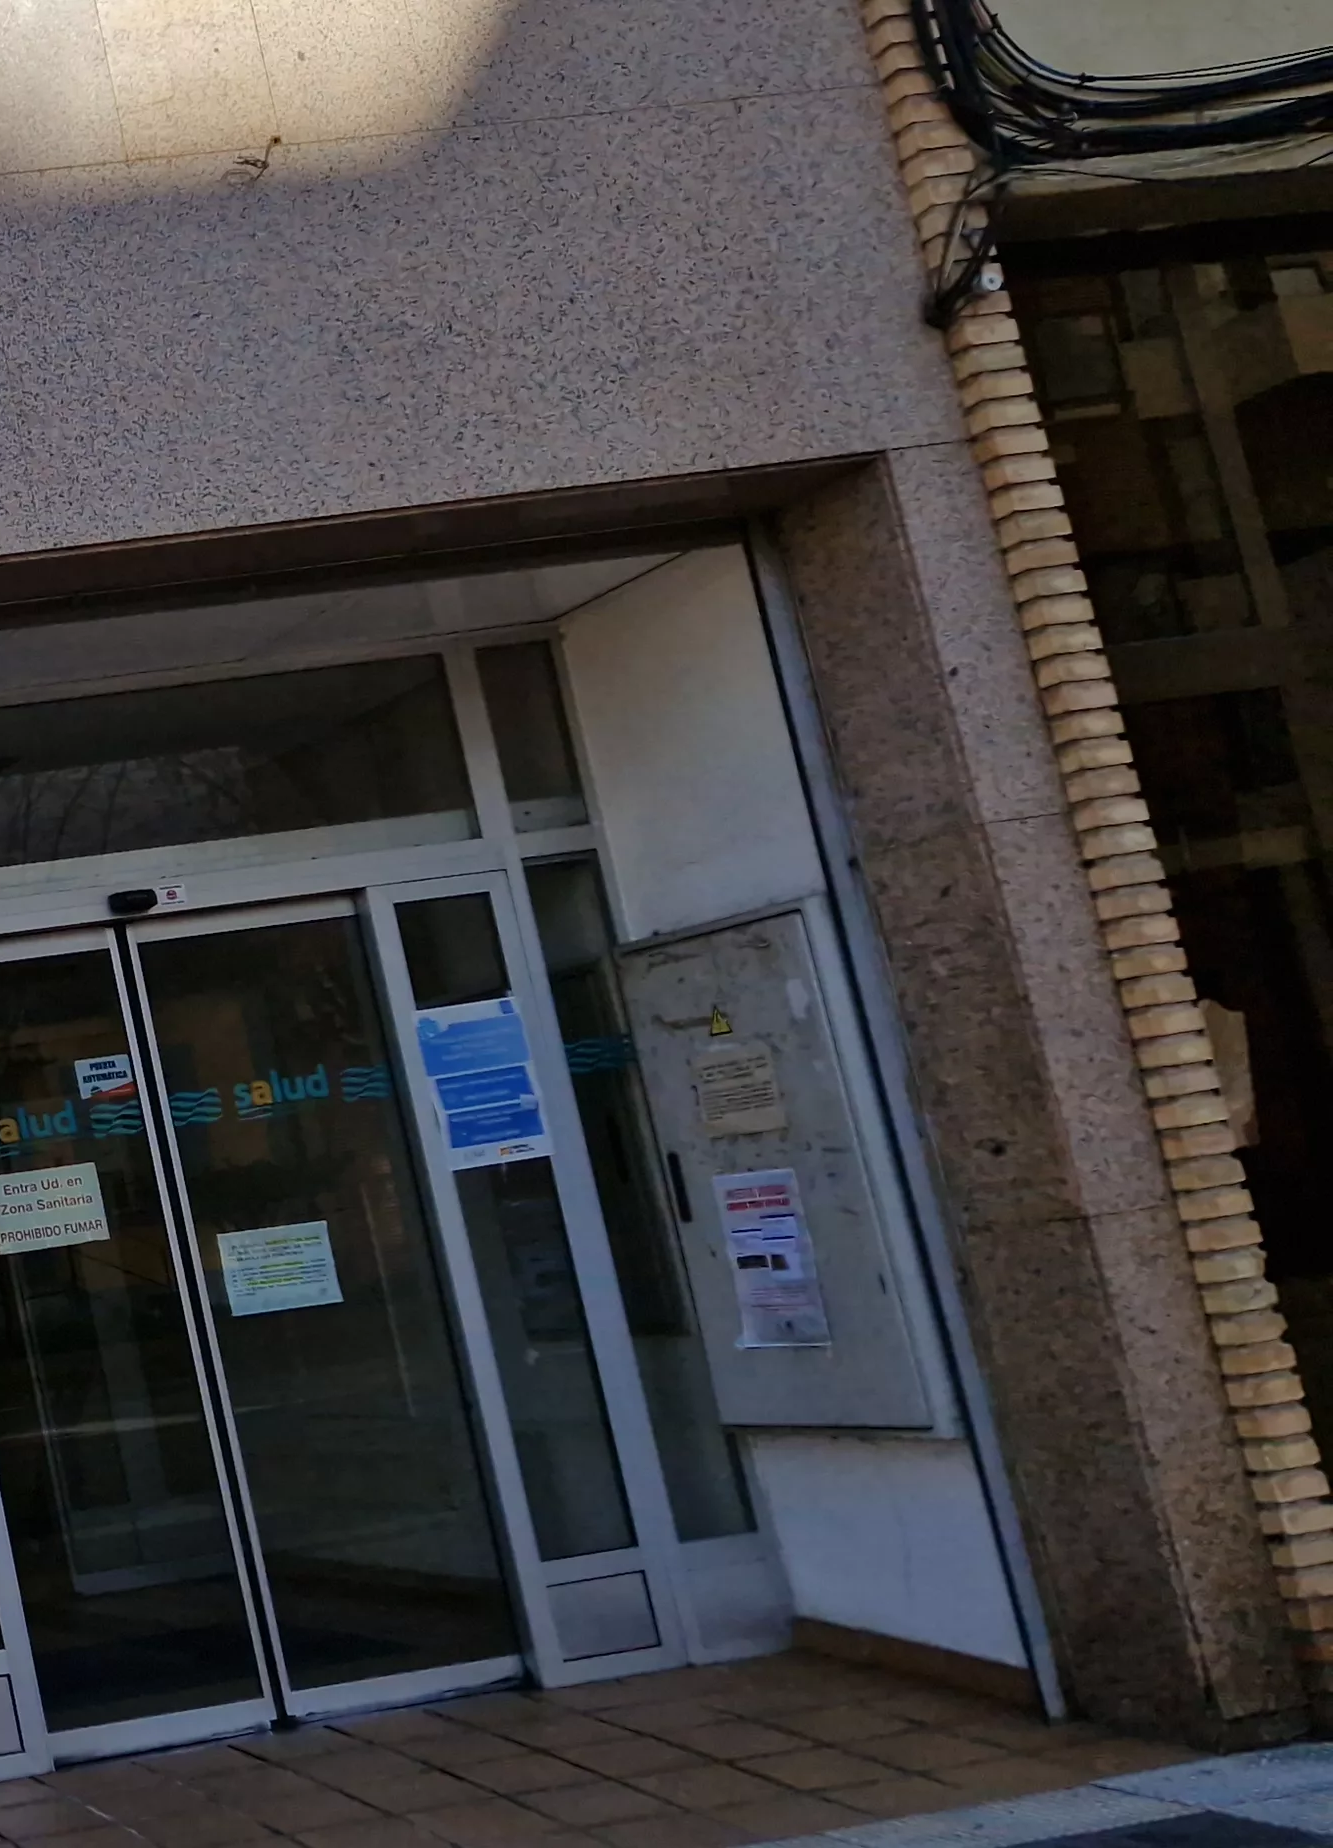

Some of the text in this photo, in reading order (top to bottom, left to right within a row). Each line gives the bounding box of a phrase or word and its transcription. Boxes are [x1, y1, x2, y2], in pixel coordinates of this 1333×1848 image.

[234, 1063, 329, 1109] salud
[3, 1176, 83, 1196] Entra Ud. en
[0, 1194, 93, 1216] Zona Sanitaria
[0, 1219, 103, 1244] PROHIBIDO FUMAR
